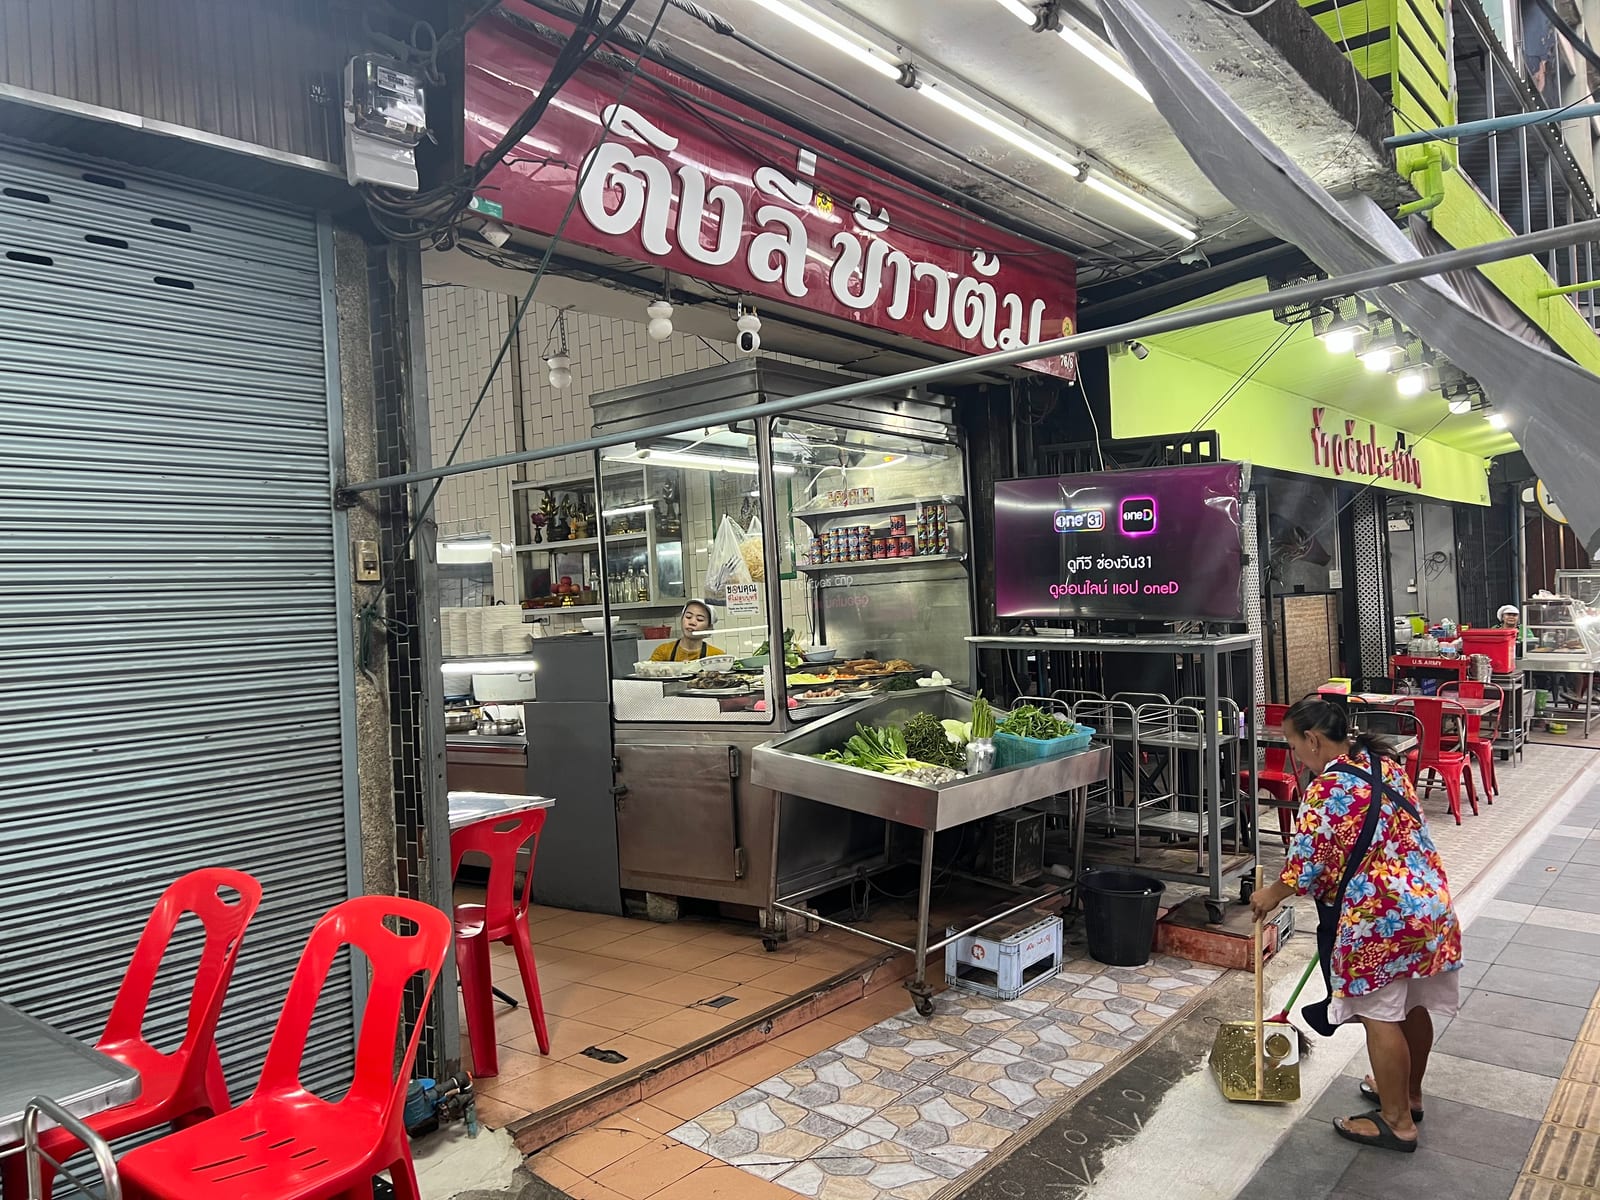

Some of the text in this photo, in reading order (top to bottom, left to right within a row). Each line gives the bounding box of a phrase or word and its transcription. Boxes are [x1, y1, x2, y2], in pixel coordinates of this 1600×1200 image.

[830, 197, 1046, 351] ข้าวต้ม
[1088, 513, 1103, 526] 31
[1123, 508, 1153, 521] oneD
[1067, 553, 1152, 573] ดูทีวี ช่องวัน31
[1049, 578, 1179, 599] ดูออนไลน์ แอป oneD
